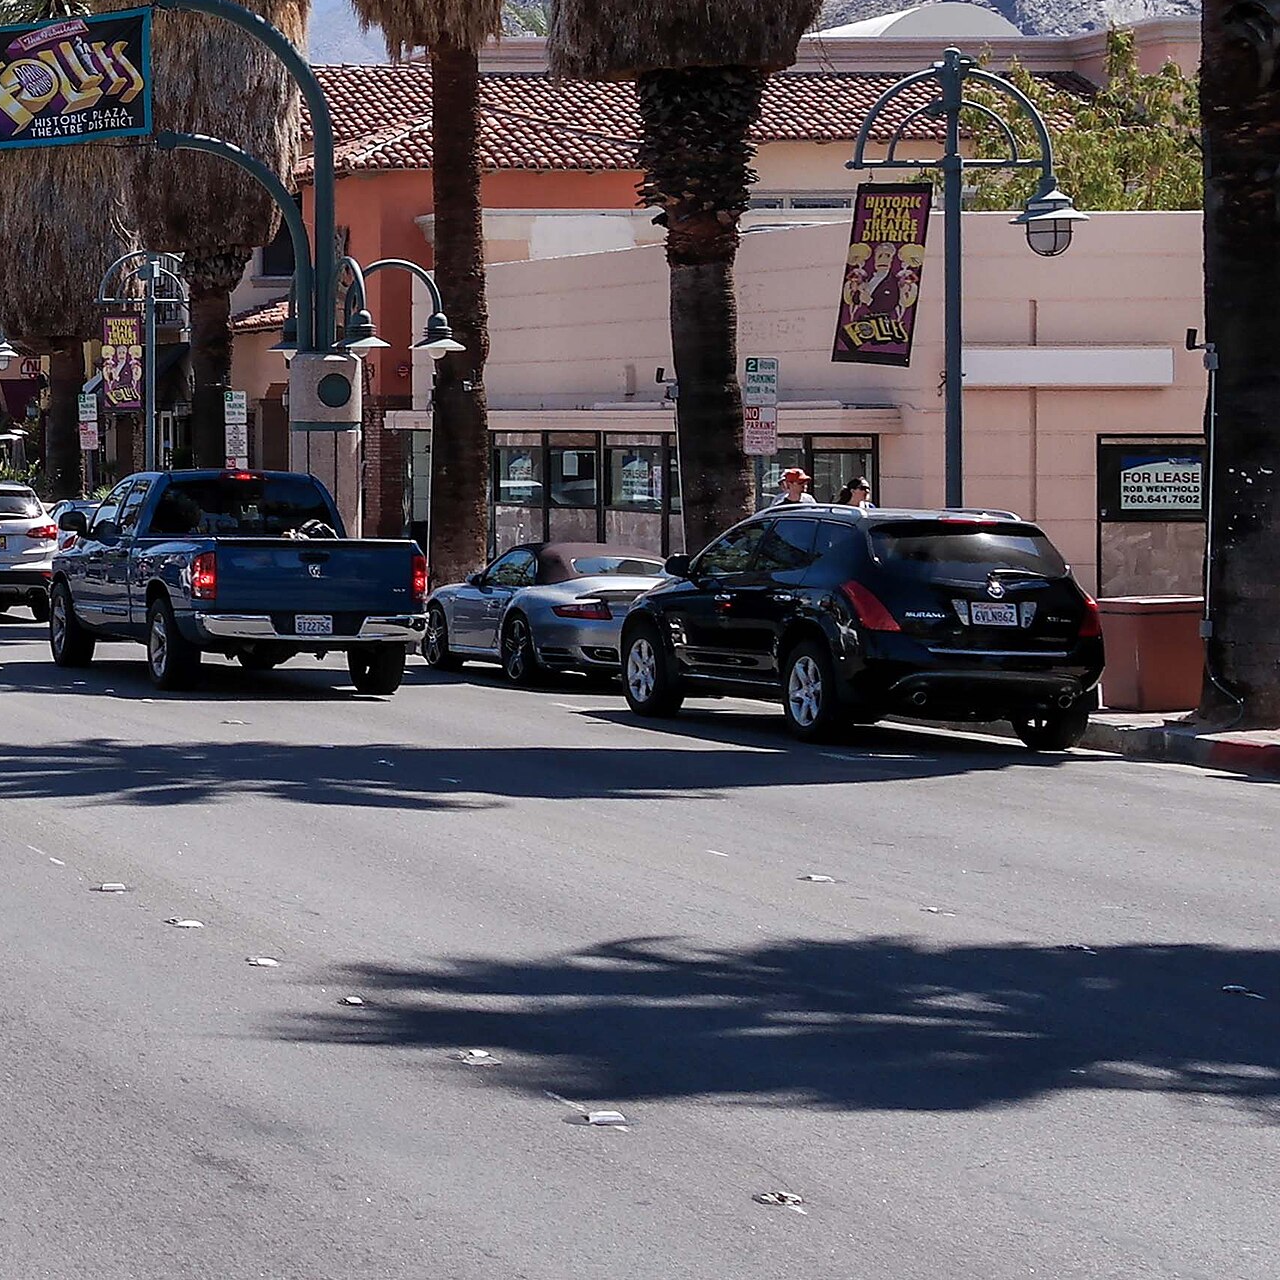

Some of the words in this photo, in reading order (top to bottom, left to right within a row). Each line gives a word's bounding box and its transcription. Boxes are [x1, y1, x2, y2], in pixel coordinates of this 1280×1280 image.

[34, 111, 87, 128] HISTORIC
[92, 107, 129, 120] PLAZA
[30, 123, 83, 138] THEATRE
[88, 116, 134, 131] DISTRICT
[865, 196, 922, 209] HISTORIC
[873, 207, 911, 220] PLAZA
[865, 219, 918, 232] THEATRE
[861, 230, 918, 243] DISTRICT
[747, 360, 757, 371] 2
[745, 408, 758, 419] NO
[1123, 472, 1152, 483] FOR
[1155, 472, 1200, 483] LEASE
[1123, 494, 1200, 503] 760.641.7602
